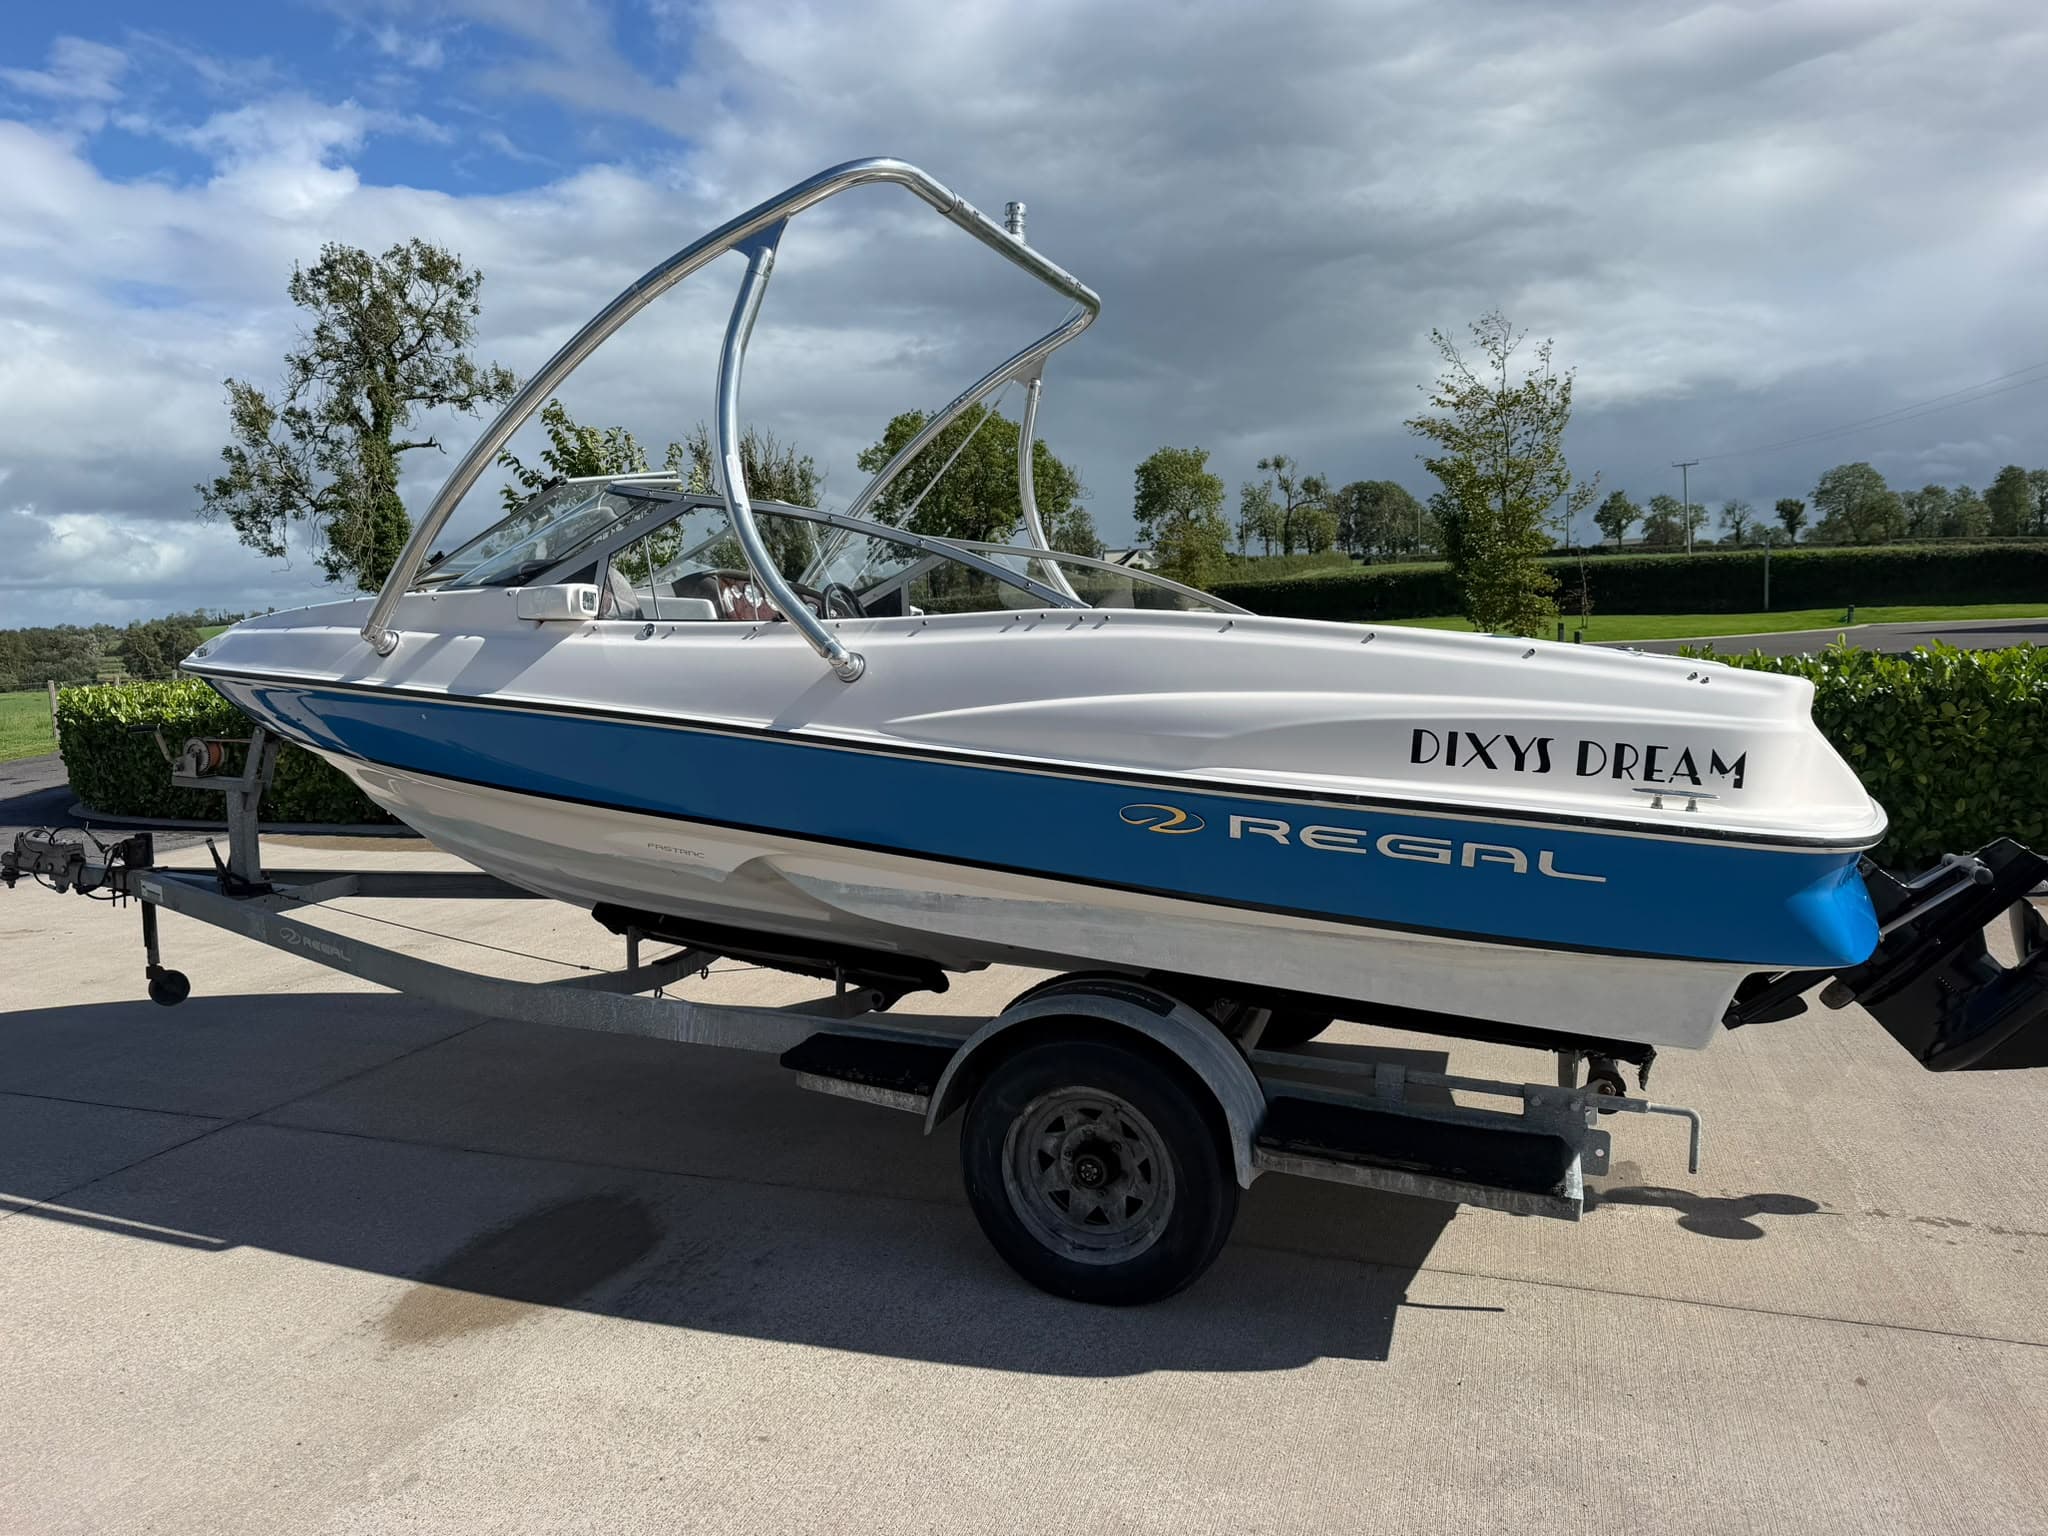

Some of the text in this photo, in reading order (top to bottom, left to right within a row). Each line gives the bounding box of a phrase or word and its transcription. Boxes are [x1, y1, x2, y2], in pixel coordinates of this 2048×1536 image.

[1410, 728, 1748, 790] DIXYS DREAM
[1228, 814, 1607, 883] REGAL
[302, 935, 352, 962] REGAL
